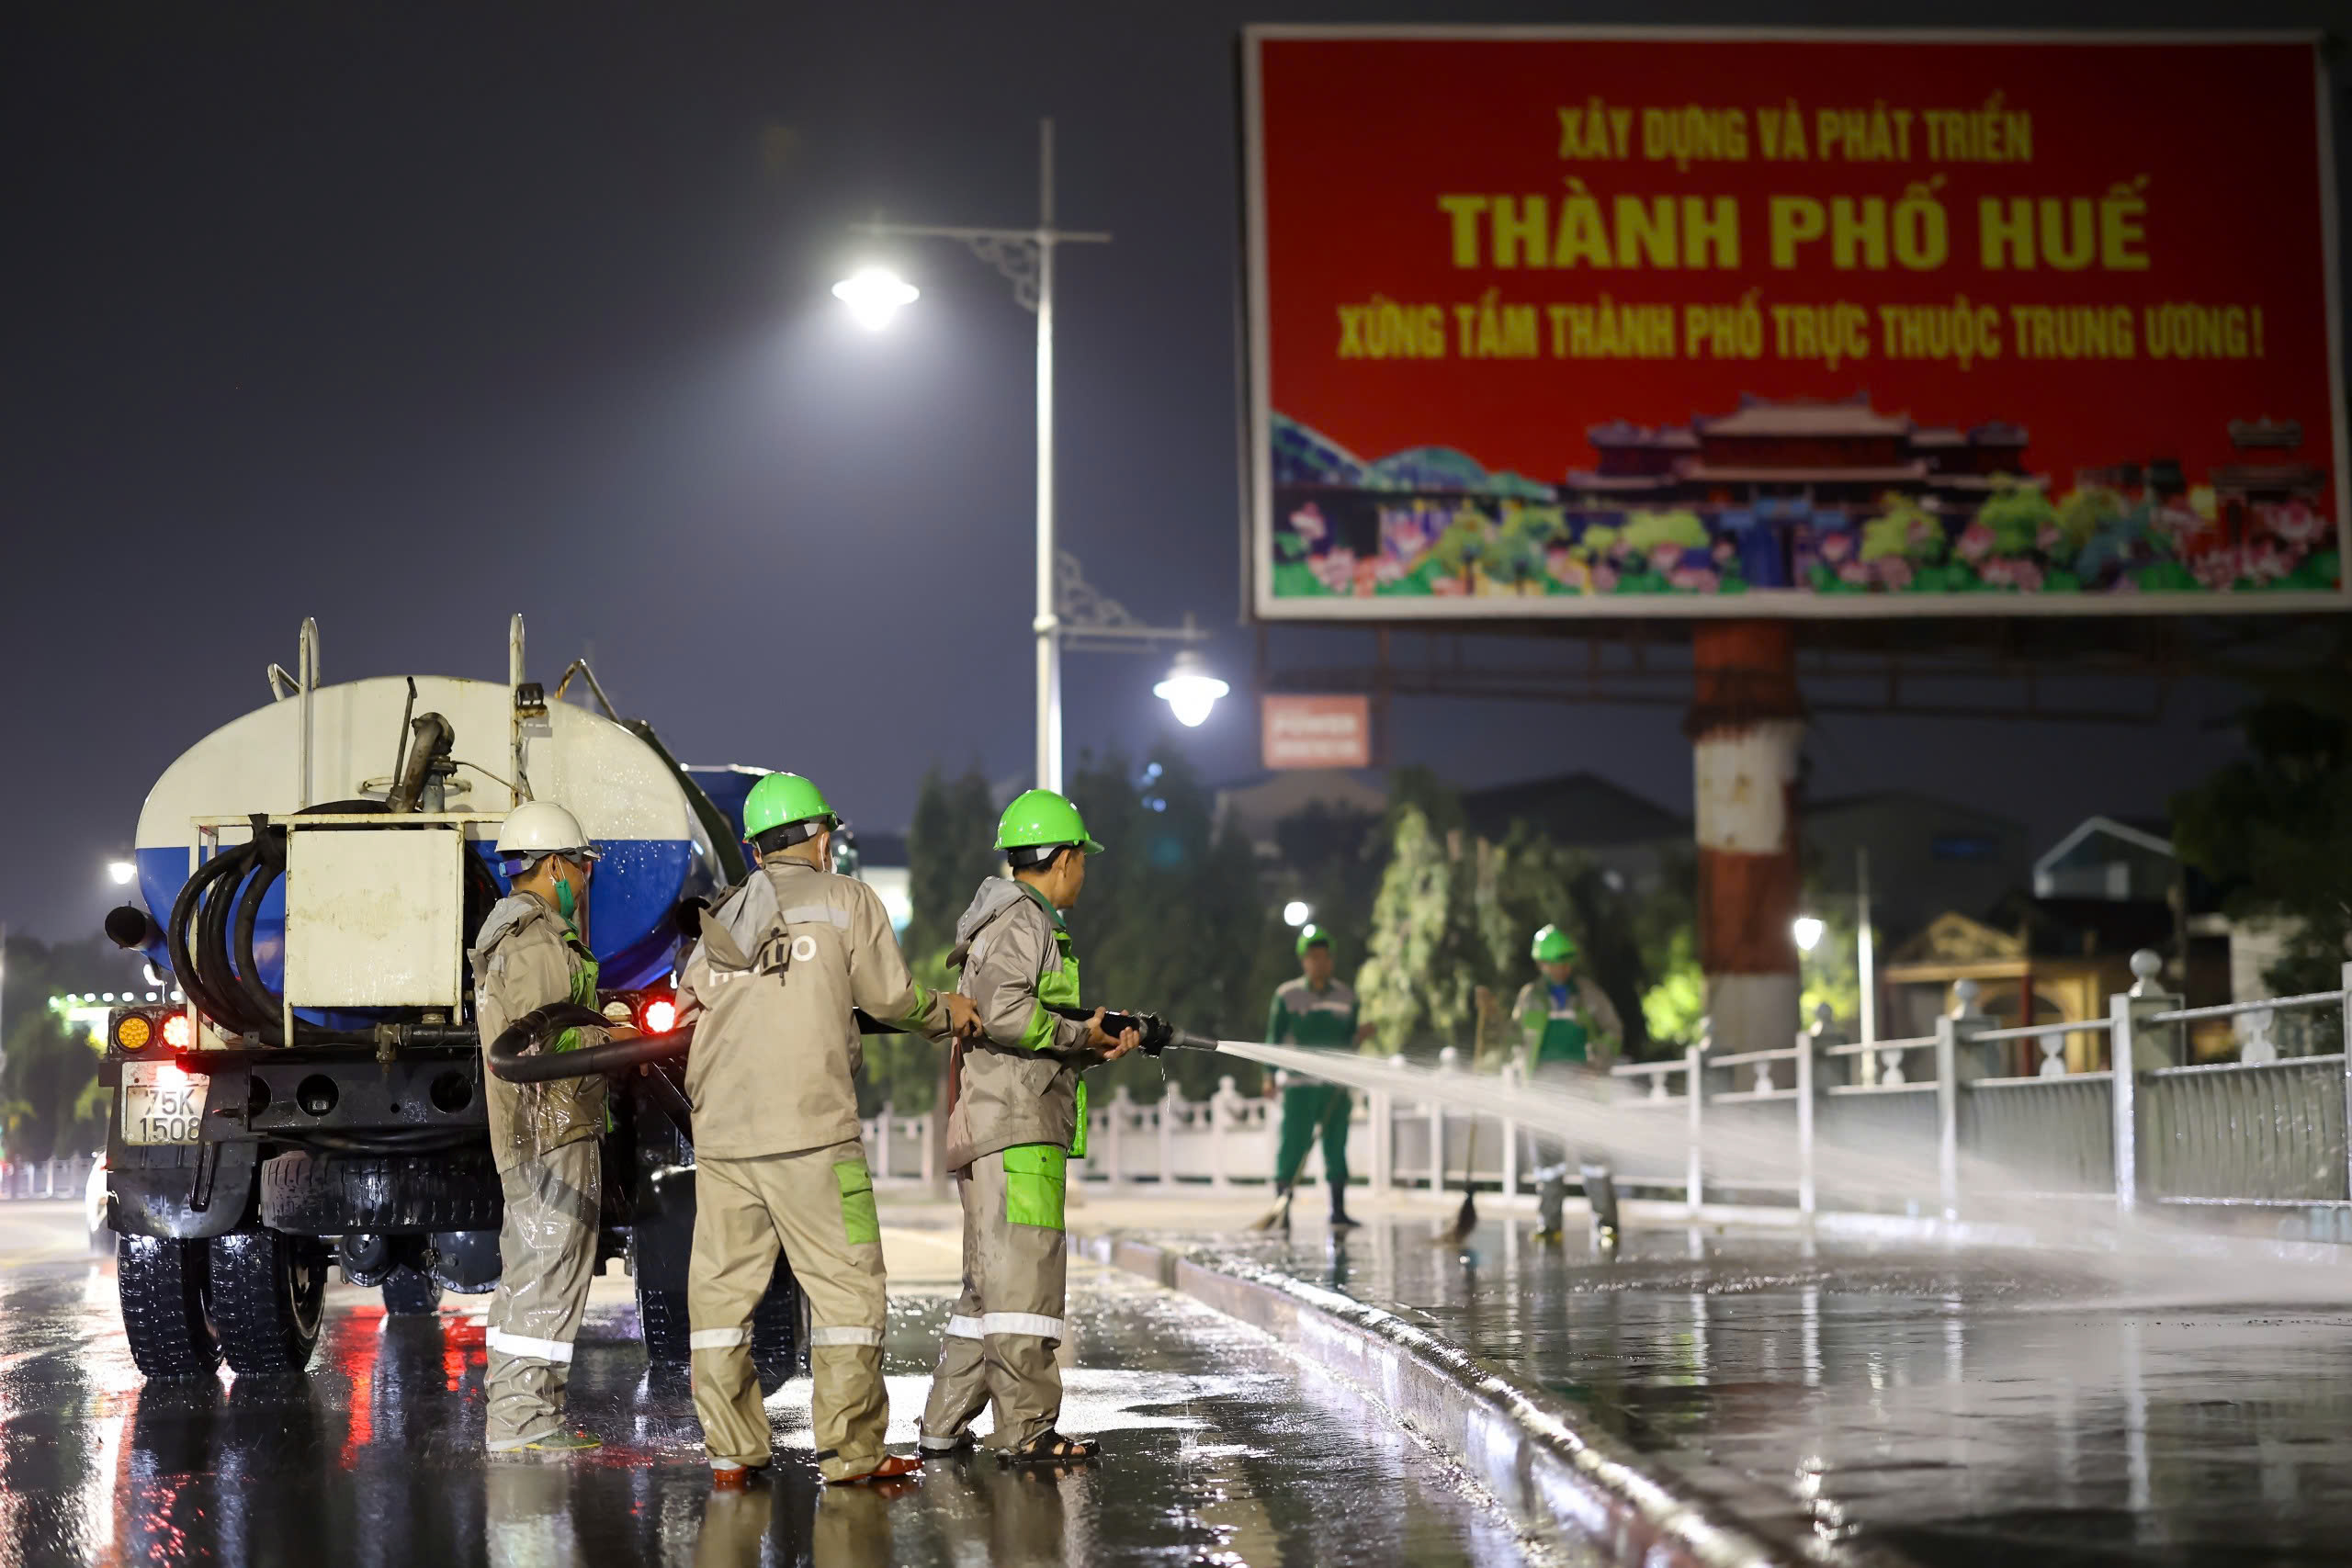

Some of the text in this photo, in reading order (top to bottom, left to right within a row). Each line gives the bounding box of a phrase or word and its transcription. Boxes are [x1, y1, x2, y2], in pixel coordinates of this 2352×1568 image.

[1438, 176, 2150, 271] THÀNH PHỐ HUẾ
[1547, 295, 1676, 358] THÀNH
[2010, 305, 2135, 359] TRUNG
[145, 1089, 196, 1116] 75K
[140, 1117, 201, 1143] 1508
